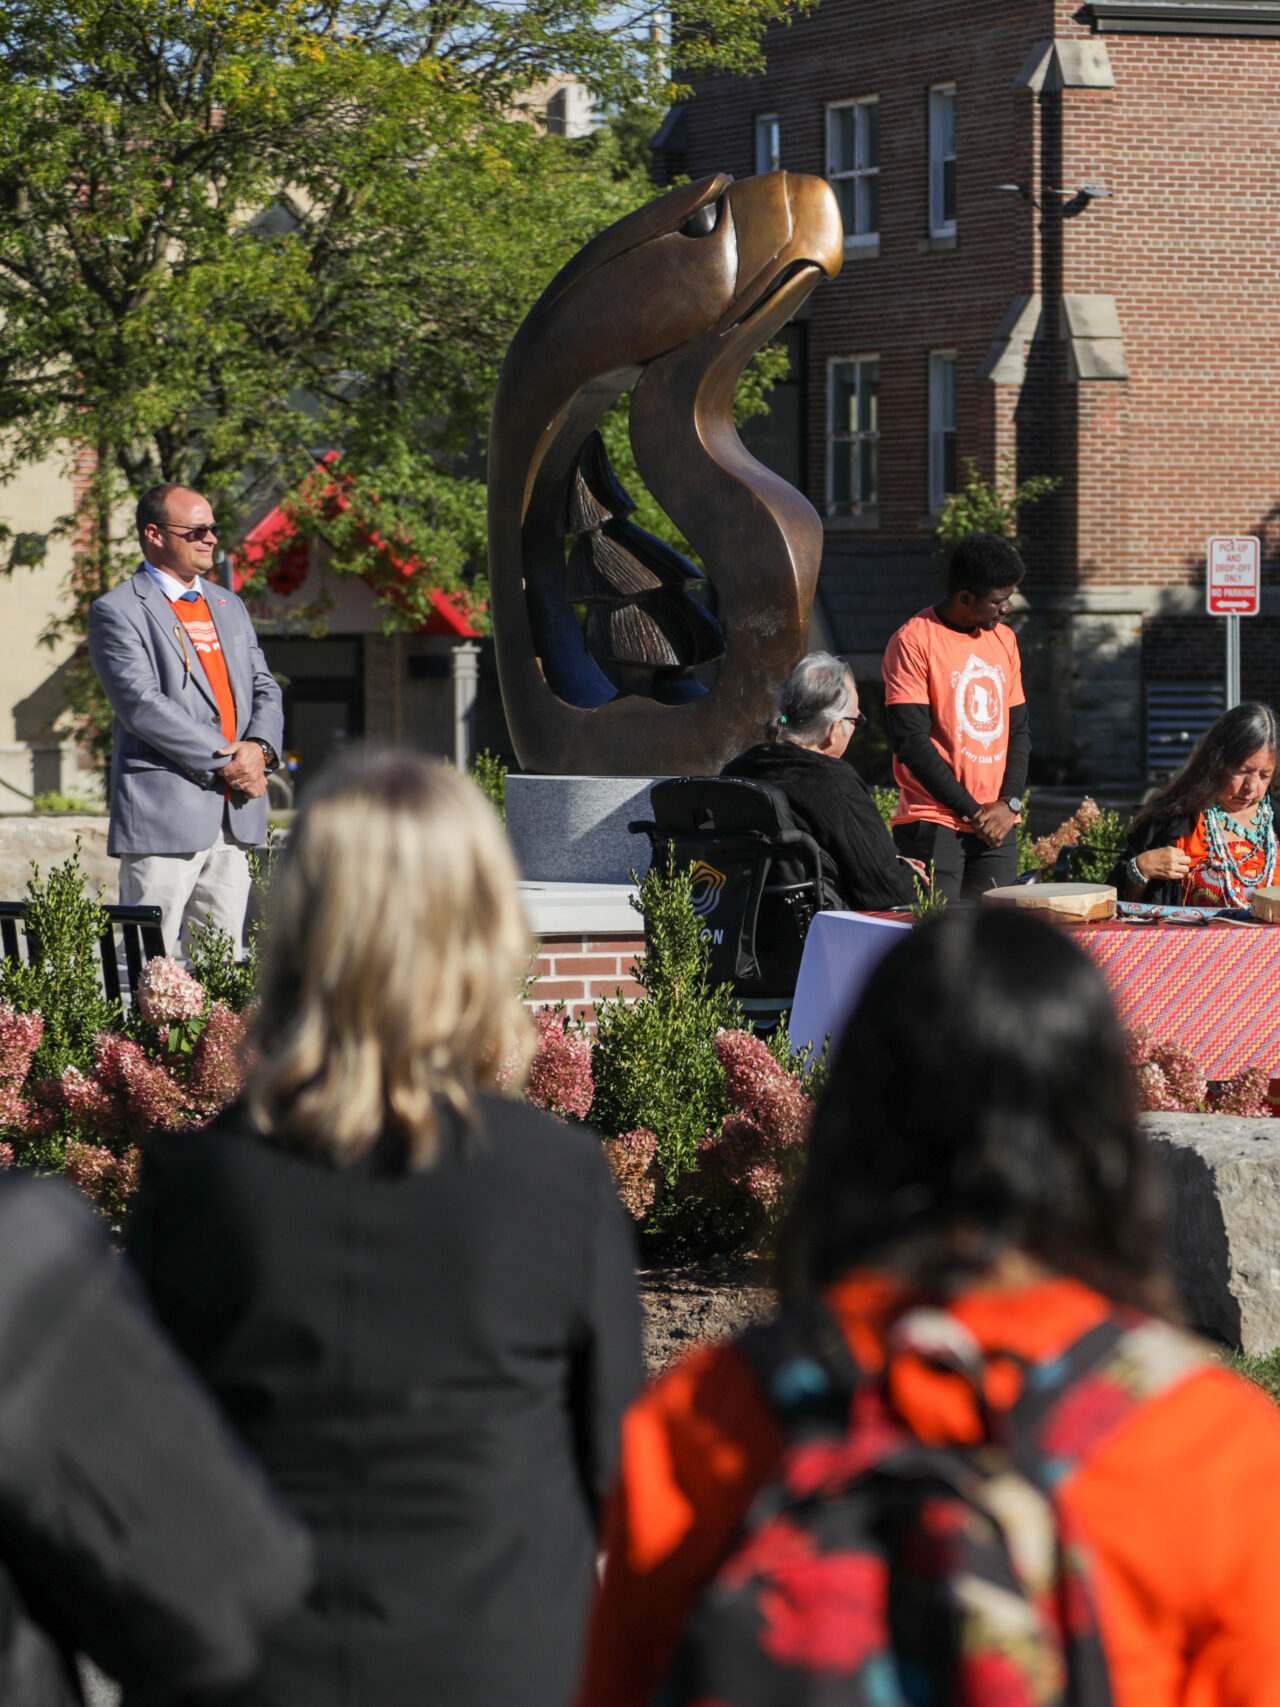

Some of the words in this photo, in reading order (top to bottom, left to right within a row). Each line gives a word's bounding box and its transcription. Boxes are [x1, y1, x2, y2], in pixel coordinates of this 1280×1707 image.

[1227, 554, 1242, 562] AND
[1215, 564, 1251, 572] DROP-OFF
[1224, 574, 1242, 582] ONLY
[1211, 588, 1223, 597] NO
[1223, 588, 1256, 597] PARKING
